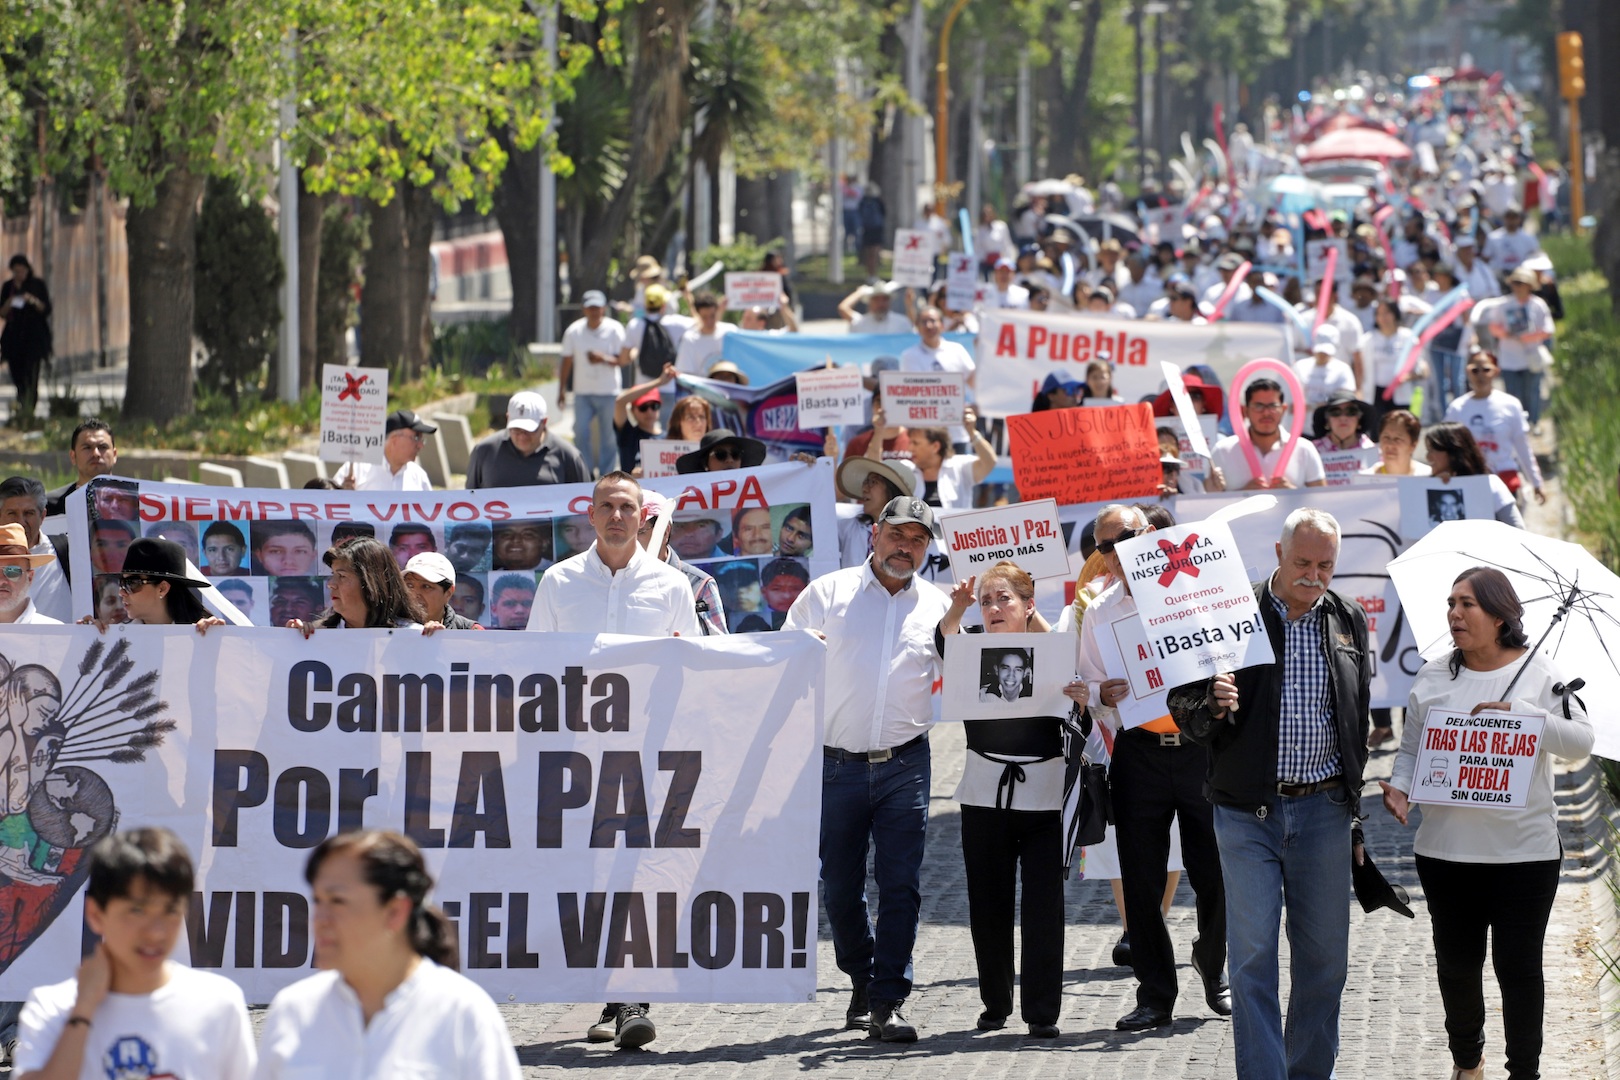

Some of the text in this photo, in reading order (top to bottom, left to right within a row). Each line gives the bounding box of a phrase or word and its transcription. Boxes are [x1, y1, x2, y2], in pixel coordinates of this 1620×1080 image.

[996, 323, 1148, 365] A Puebla
[801, 393, 861, 411] ¡Basta ya!
[909, 406, 938, 420] GENTE
[323, 431, 383, 448] ¡Basta ya!
[138, 492, 353, 522] SIEMPRE
[367, 500, 513, 522] VIVOS
[951, 518, 1057, 552] Justicia y Paz,
[969, 542, 1045, 564] NO PIDO MÁS
[1131, 549, 1227, 581] INSEGURIDAD!
[1135, 537, 1213, 567] ¡TACHE A LA
[1148, 594, 1250, 626] transporte seguro
[1164, 585, 1224, 607] Queremos
[1155, 612, 1263, 660] ¡Basta ya!
[287, 660, 630, 733] Caminata
[1445, 717, 1522, 730] DELINCUENTES
[1425, 728, 1537, 757] TRAS LAS REJAS
[1459, 755, 1514, 768] PARA UNA
[1457, 766, 1510, 791] PUEBLA
[213, 749, 702, 849] Por LA PAZ
[1450, 790, 1512, 803] SIN QUEJAS
[185, 891, 317, 968] VID
[557, 890, 810, 970] VALOR!
